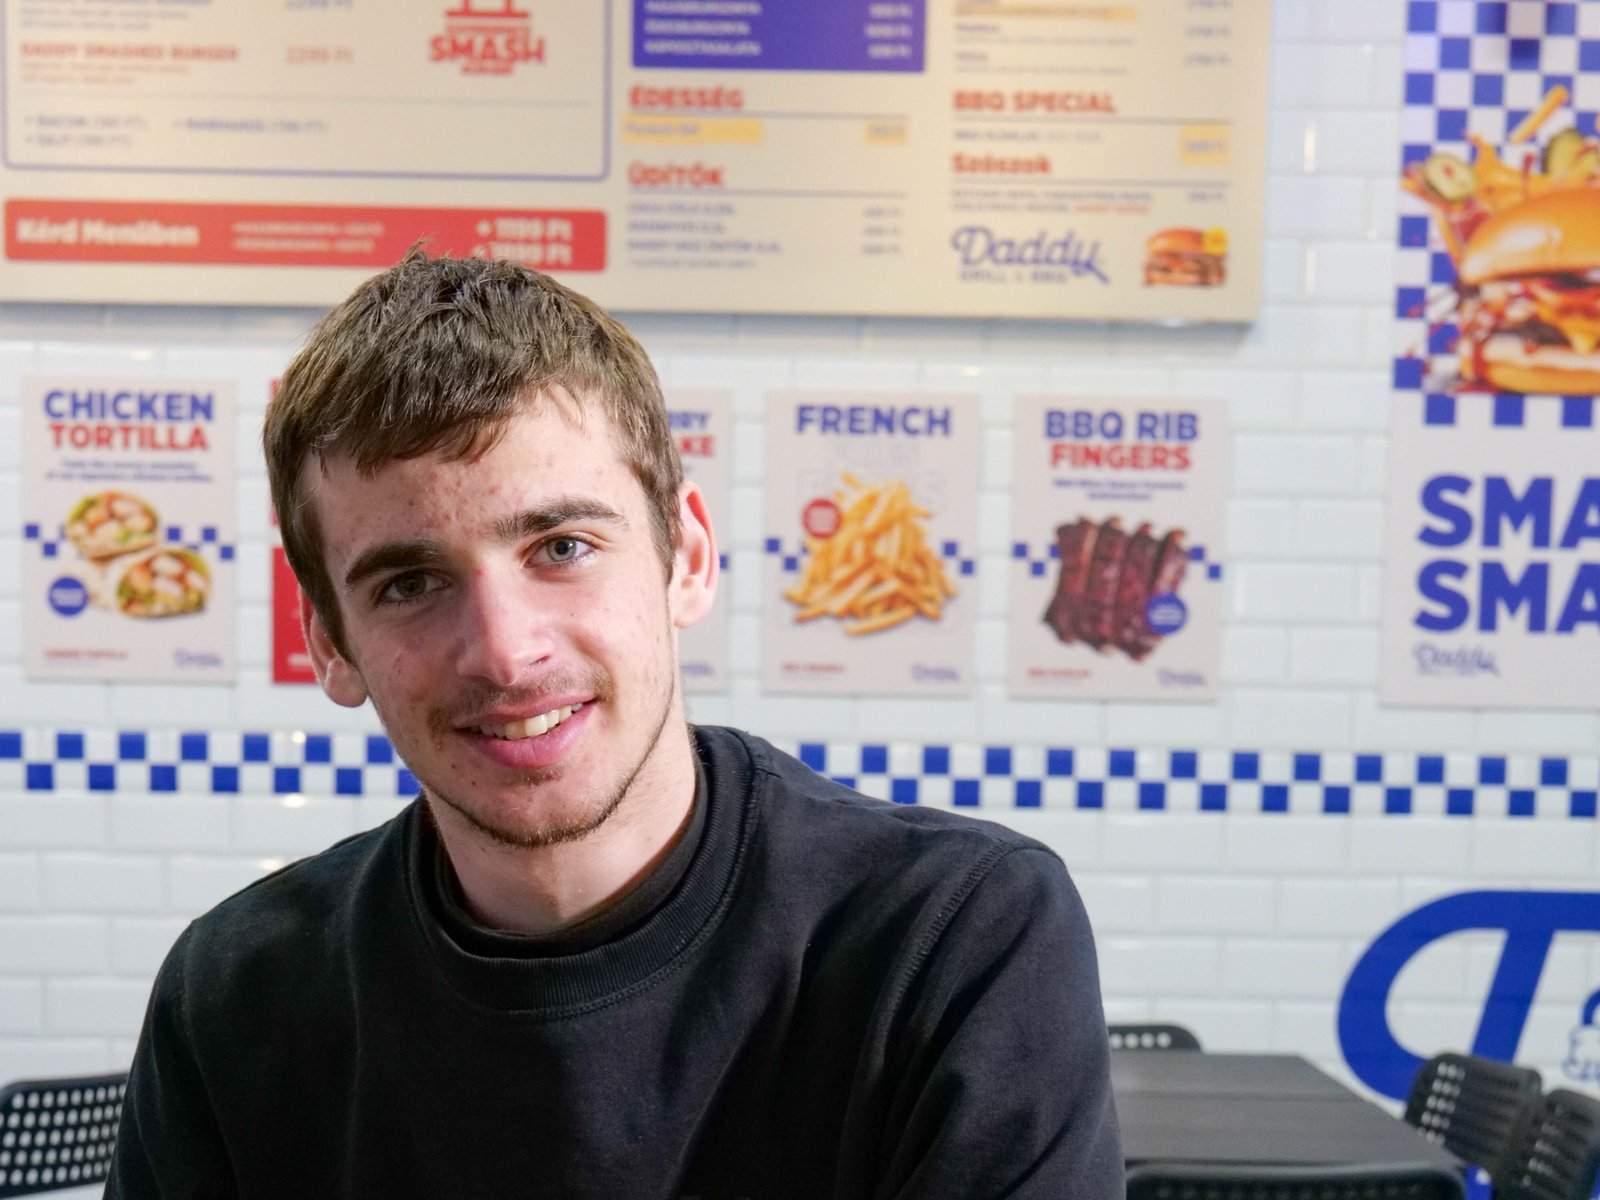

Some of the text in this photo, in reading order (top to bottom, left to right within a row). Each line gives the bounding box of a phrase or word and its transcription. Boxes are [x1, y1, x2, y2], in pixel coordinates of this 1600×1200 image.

[429, 35, 545, 62] SMASH
[1014, 92, 1117, 115] SPECIAL
[951, 226, 1110, 285] Daddy
[45, 390, 213, 421] CHICKEN
[797, 404, 951, 436] FRENCH
[49, 423, 208, 451] TORTILLA
[1045, 409, 1198, 441] BBQ RIB
[1050, 442, 1192, 470] FINGERS
